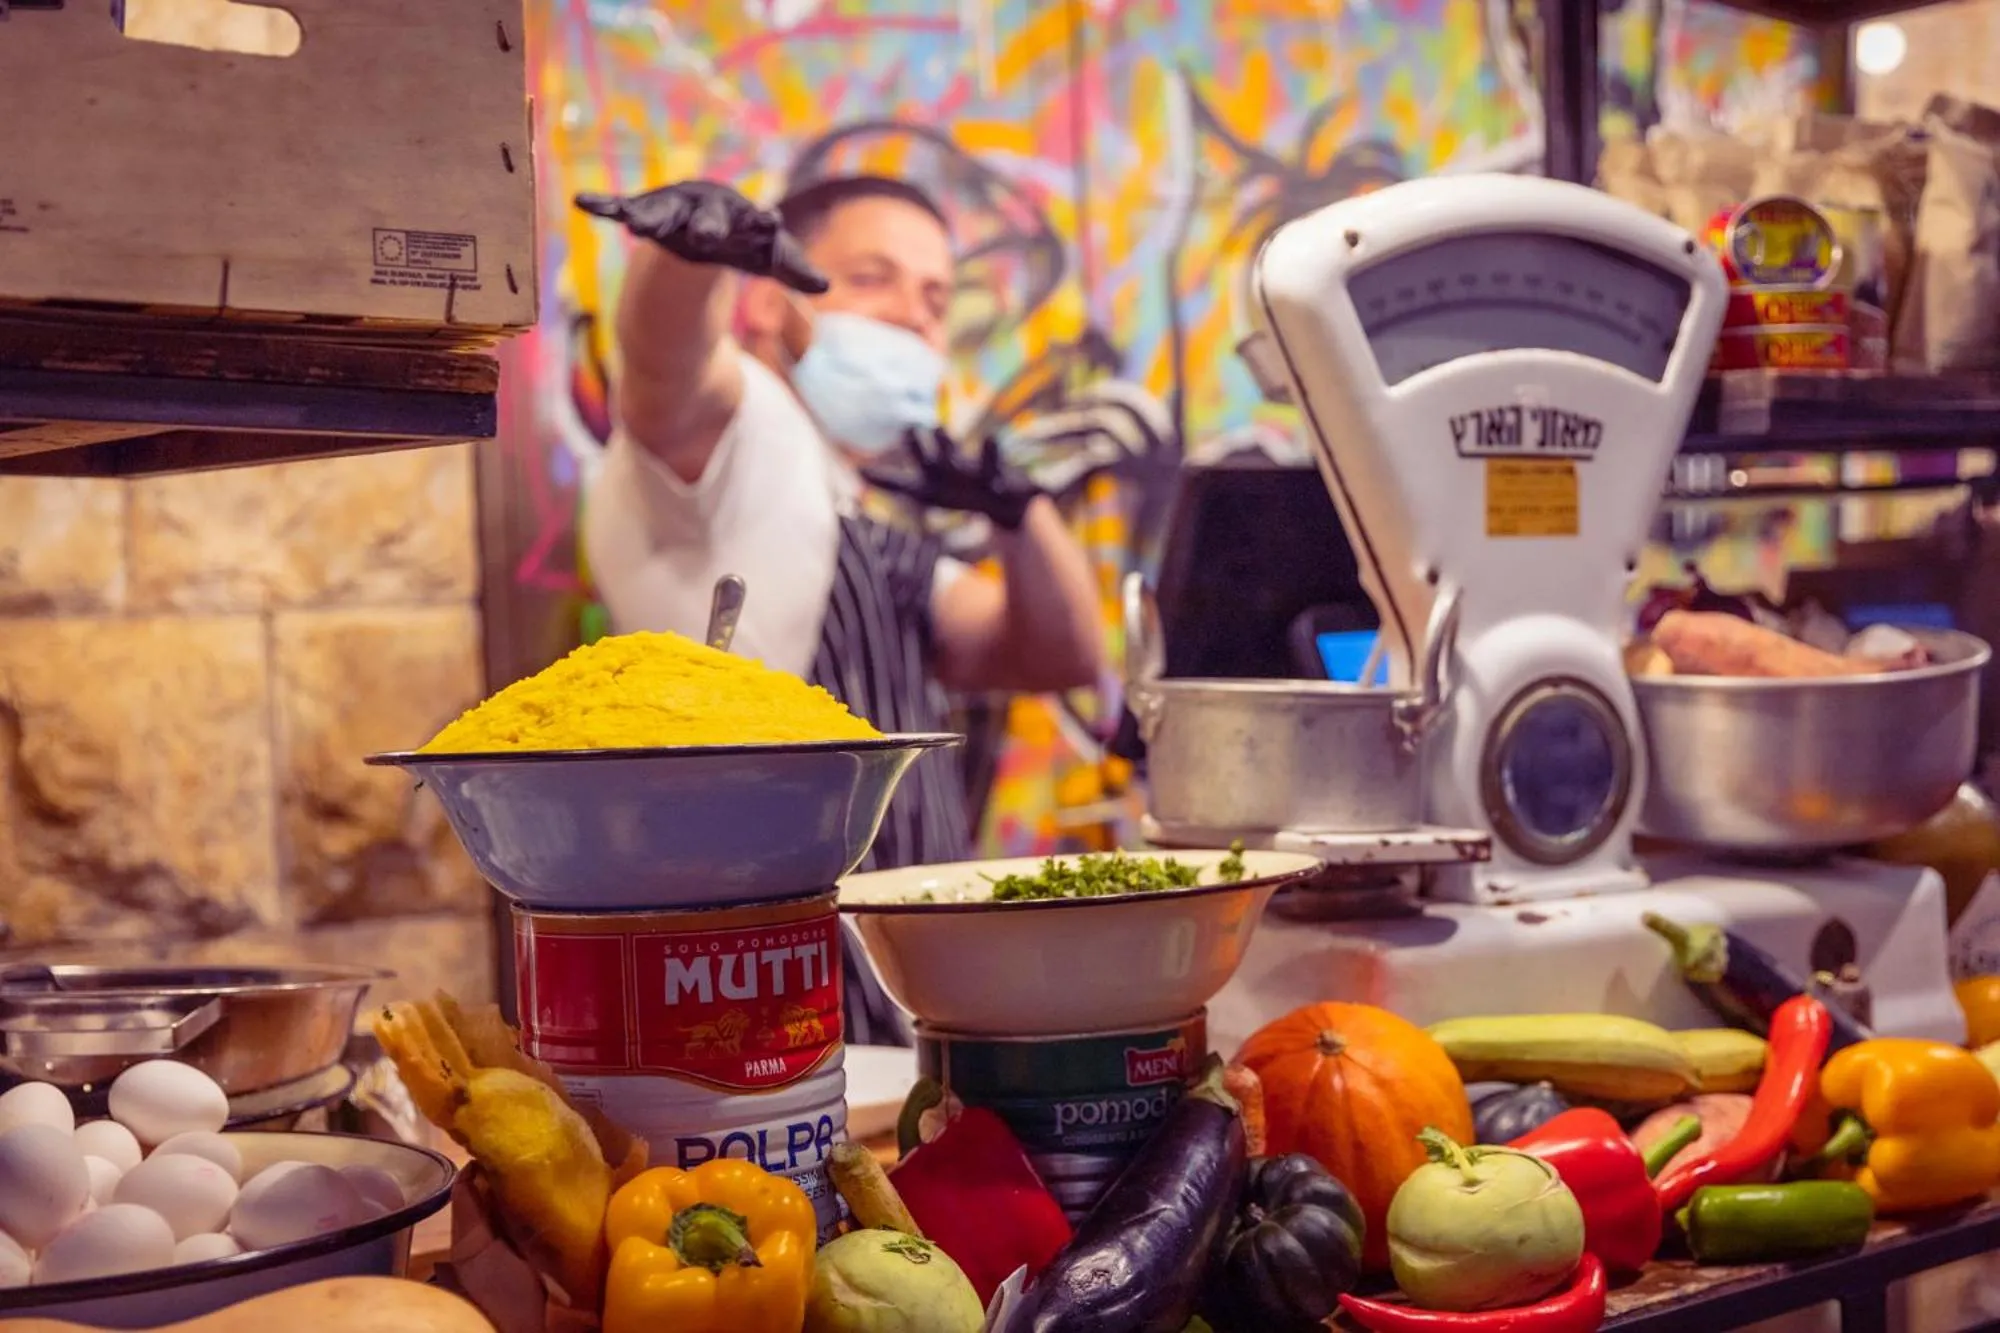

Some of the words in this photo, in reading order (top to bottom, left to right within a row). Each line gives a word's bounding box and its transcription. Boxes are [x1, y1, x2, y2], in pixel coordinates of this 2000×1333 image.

[663, 941, 720, 955] SOLO
[664, 940, 829, 1006] MUTTI
[744, 1056, 787, 1078] PARMA
[1134, 1056, 1178, 1079] MEN
[1053, 1087, 1168, 1135] pomod
[674, 1114, 833, 1172] POLPA
